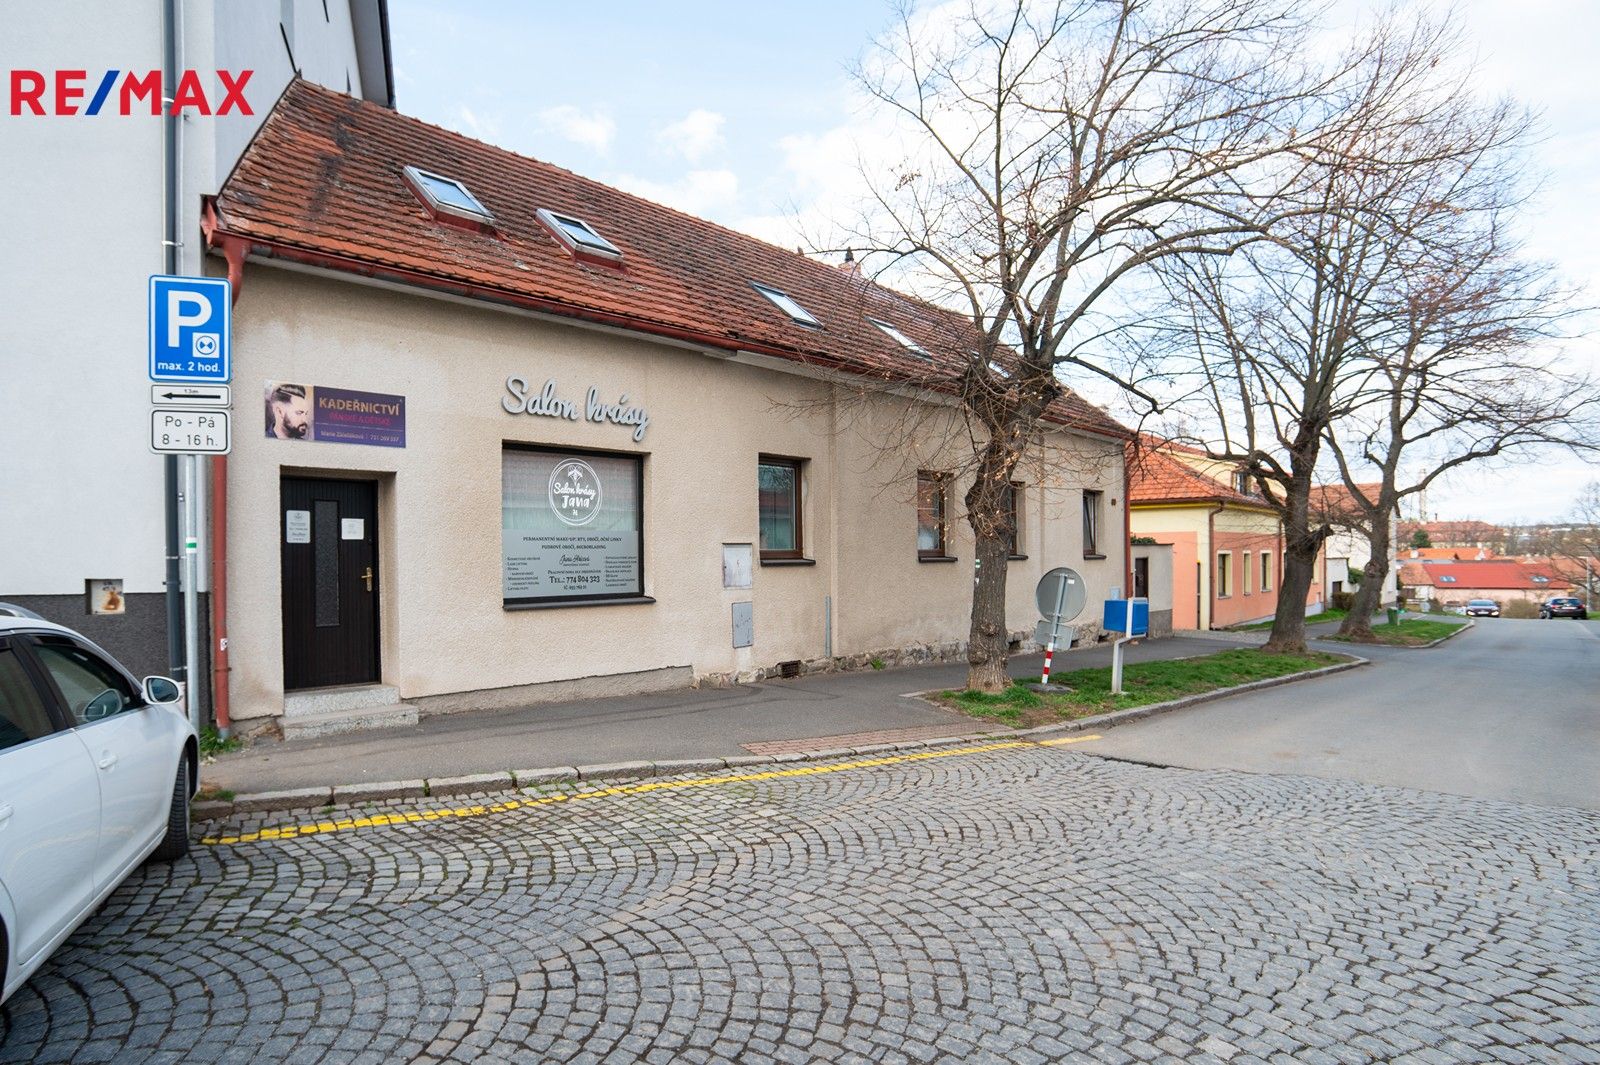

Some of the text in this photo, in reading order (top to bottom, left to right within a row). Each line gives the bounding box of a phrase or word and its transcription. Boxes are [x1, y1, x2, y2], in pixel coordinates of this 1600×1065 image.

[167, 289, 213, 348] P
[157, 361, 221, 373] max. 2 hod.
[319, 397, 400, 416] KADEŘNICTVÍ
[501, 372, 650, 443] Salon krásy
[165, 415, 182, 427] Po
[198, 416, 215, 428] Pá
[162, 433, 170, 445] 8
[187, 434, 201, 446] 16
[206, 435, 218, 447] h.
[553, 482, 597, 500] Salon krásy
[566, 576, 577, 584] 774
[577, 575, 589, 583] 804
[589, 575, 601, 583] 323
